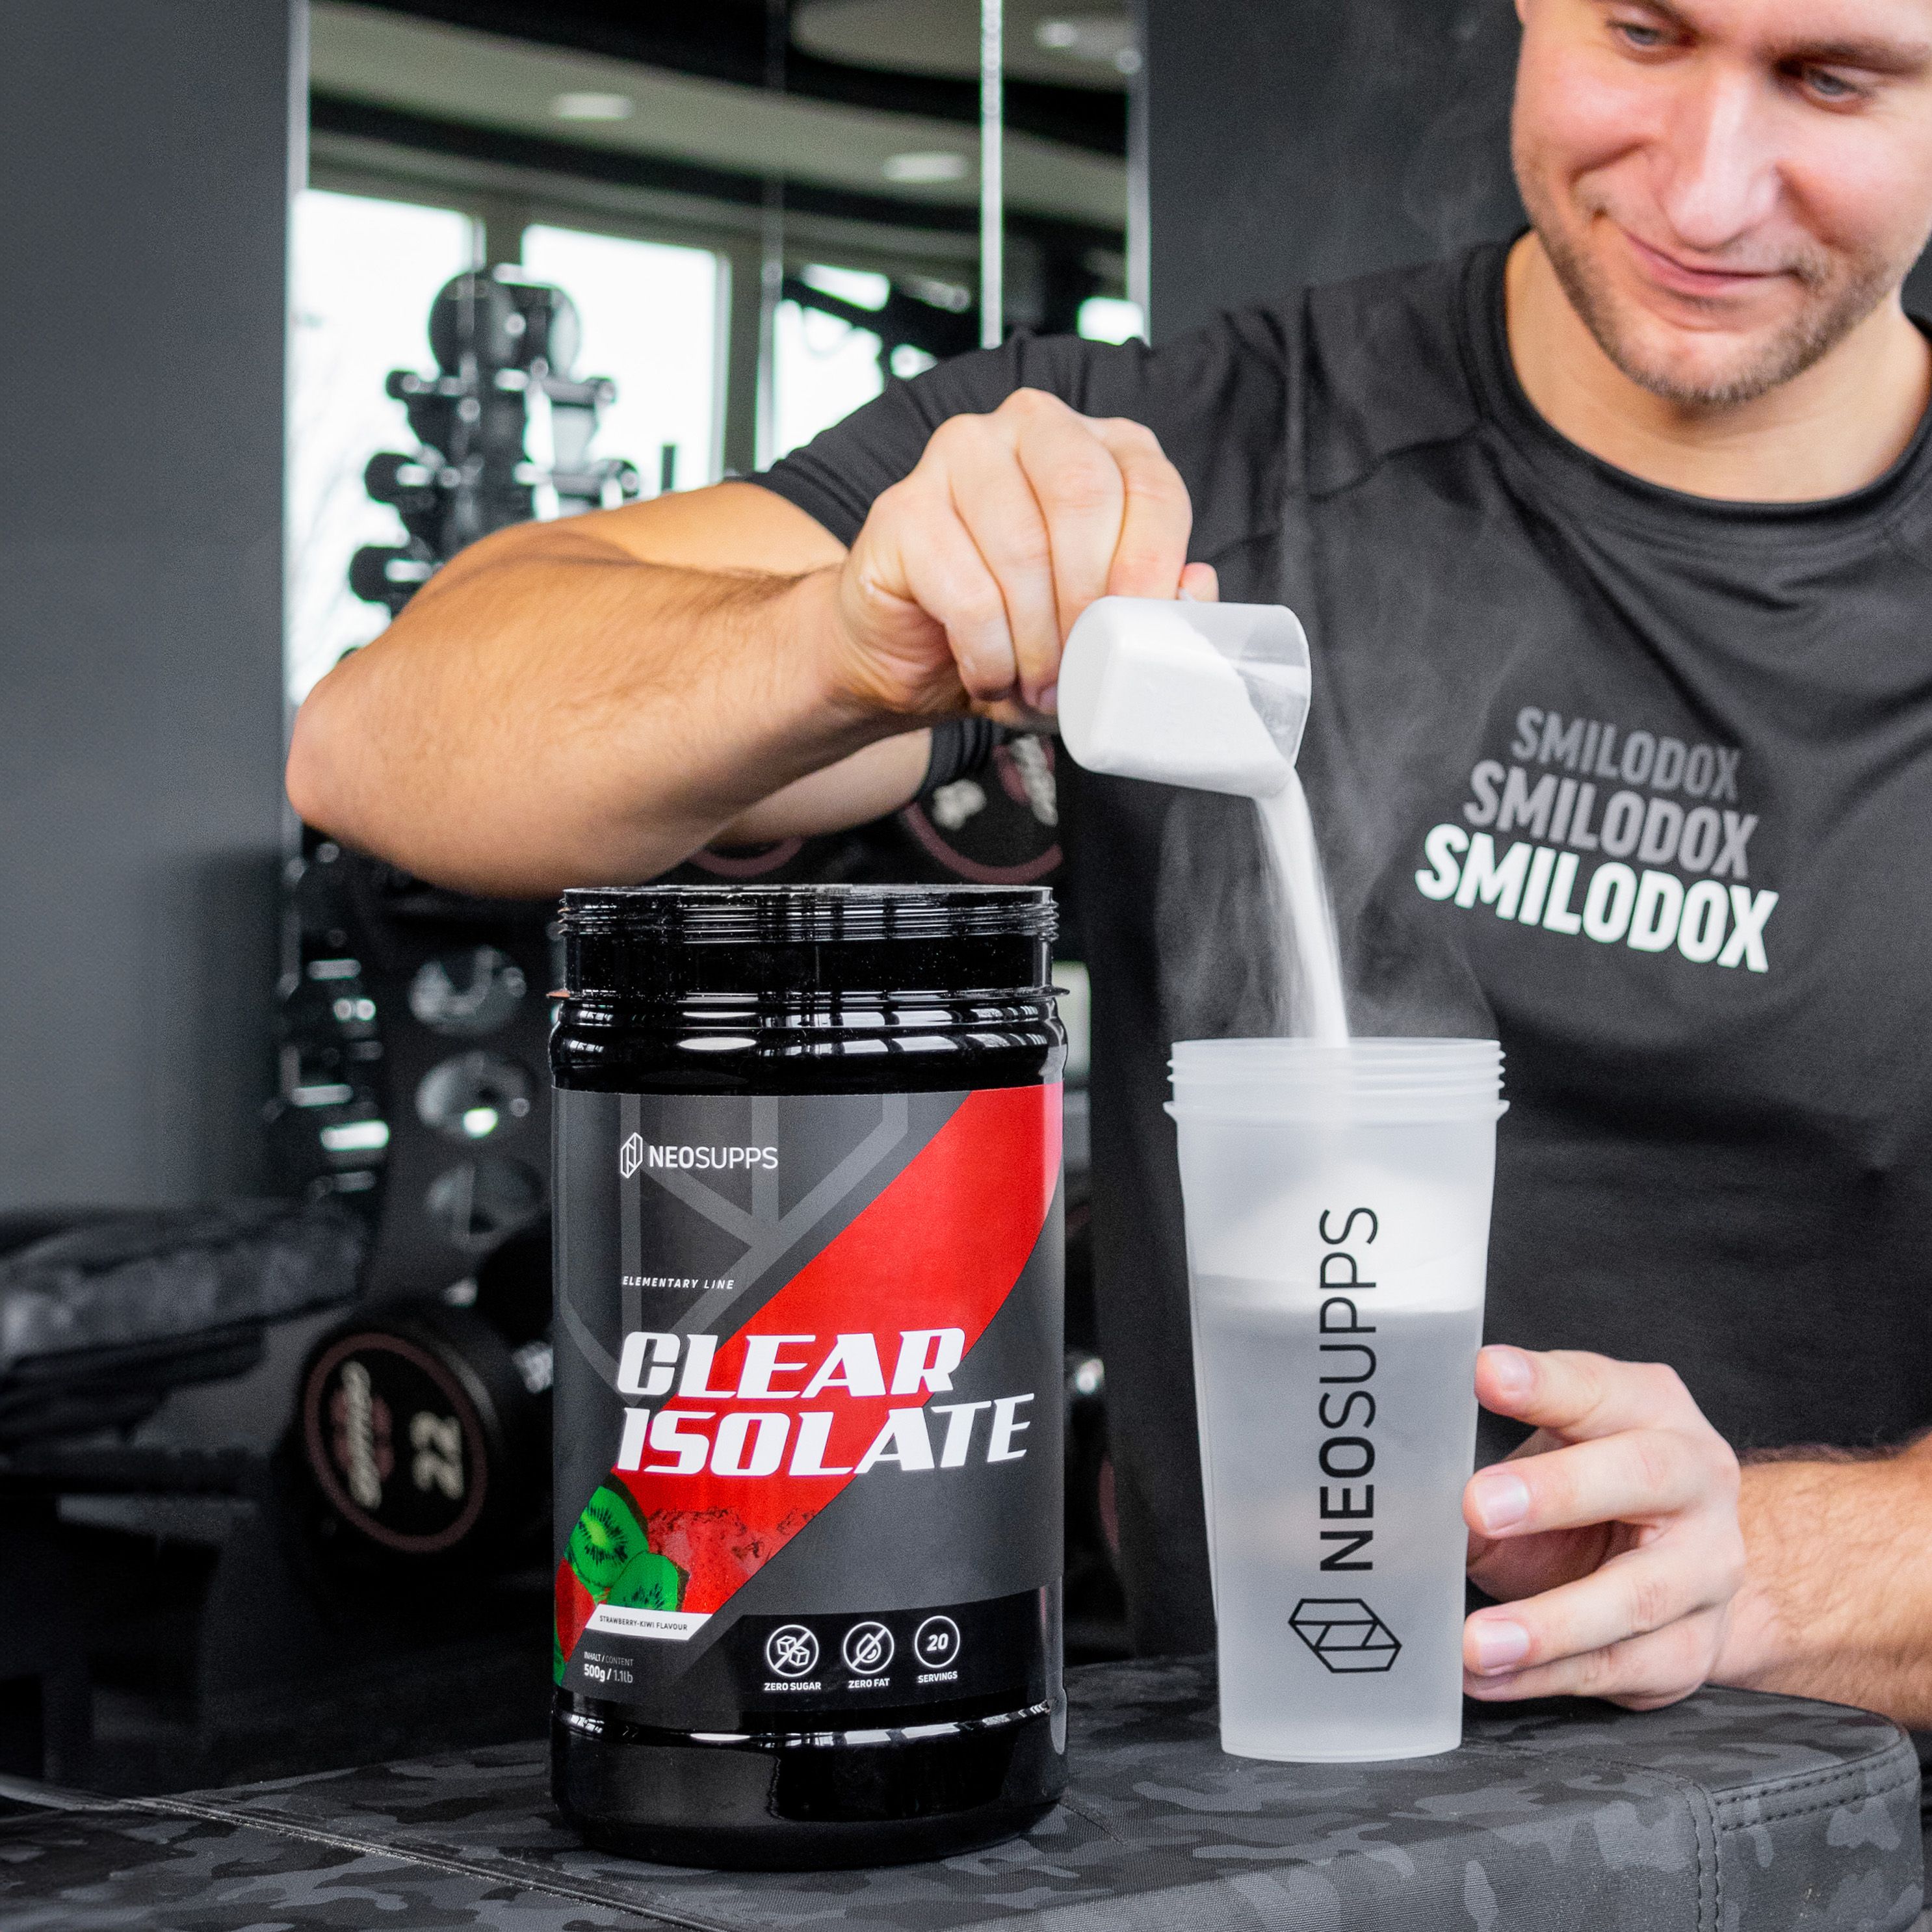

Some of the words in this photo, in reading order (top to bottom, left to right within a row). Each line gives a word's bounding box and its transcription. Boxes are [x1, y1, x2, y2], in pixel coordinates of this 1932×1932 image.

[1511, 707, 1742, 801] SMILODOX
[1463, 760, 1758, 879] SMILODOX
[1415, 824, 1779, 973] SMILODOX
[649, 1145, 779, 1169] NEOSUPPS
[622, 1275, 699, 1288] ELEMENTARY
[703, 1279, 735, 1290] LINE
[616, 1327, 967, 1399] CLEAR
[1318, 1207, 1378, 1571] NEOSUPPS
[616, 1393, 1035, 1477] ISOLATE
[599, 1615, 655, 1628] STRAWBERRY-KIWI
[656, 1622, 688, 1631] FLAVOUR
[926, 1632, 948, 1652] 20
[605, 1655, 634, 1666] CONTENT
[584, 1664, 605, 1682] 500g
[848, 1678, 872, 1689] ZERO
[874, 1677, 891, 1687] FAT
[918, 1671, 958, 1684] SERVINGS
[764, 1682, 789, 1691] ZERO
[790, 1682, 821, 1691] SUGAR
